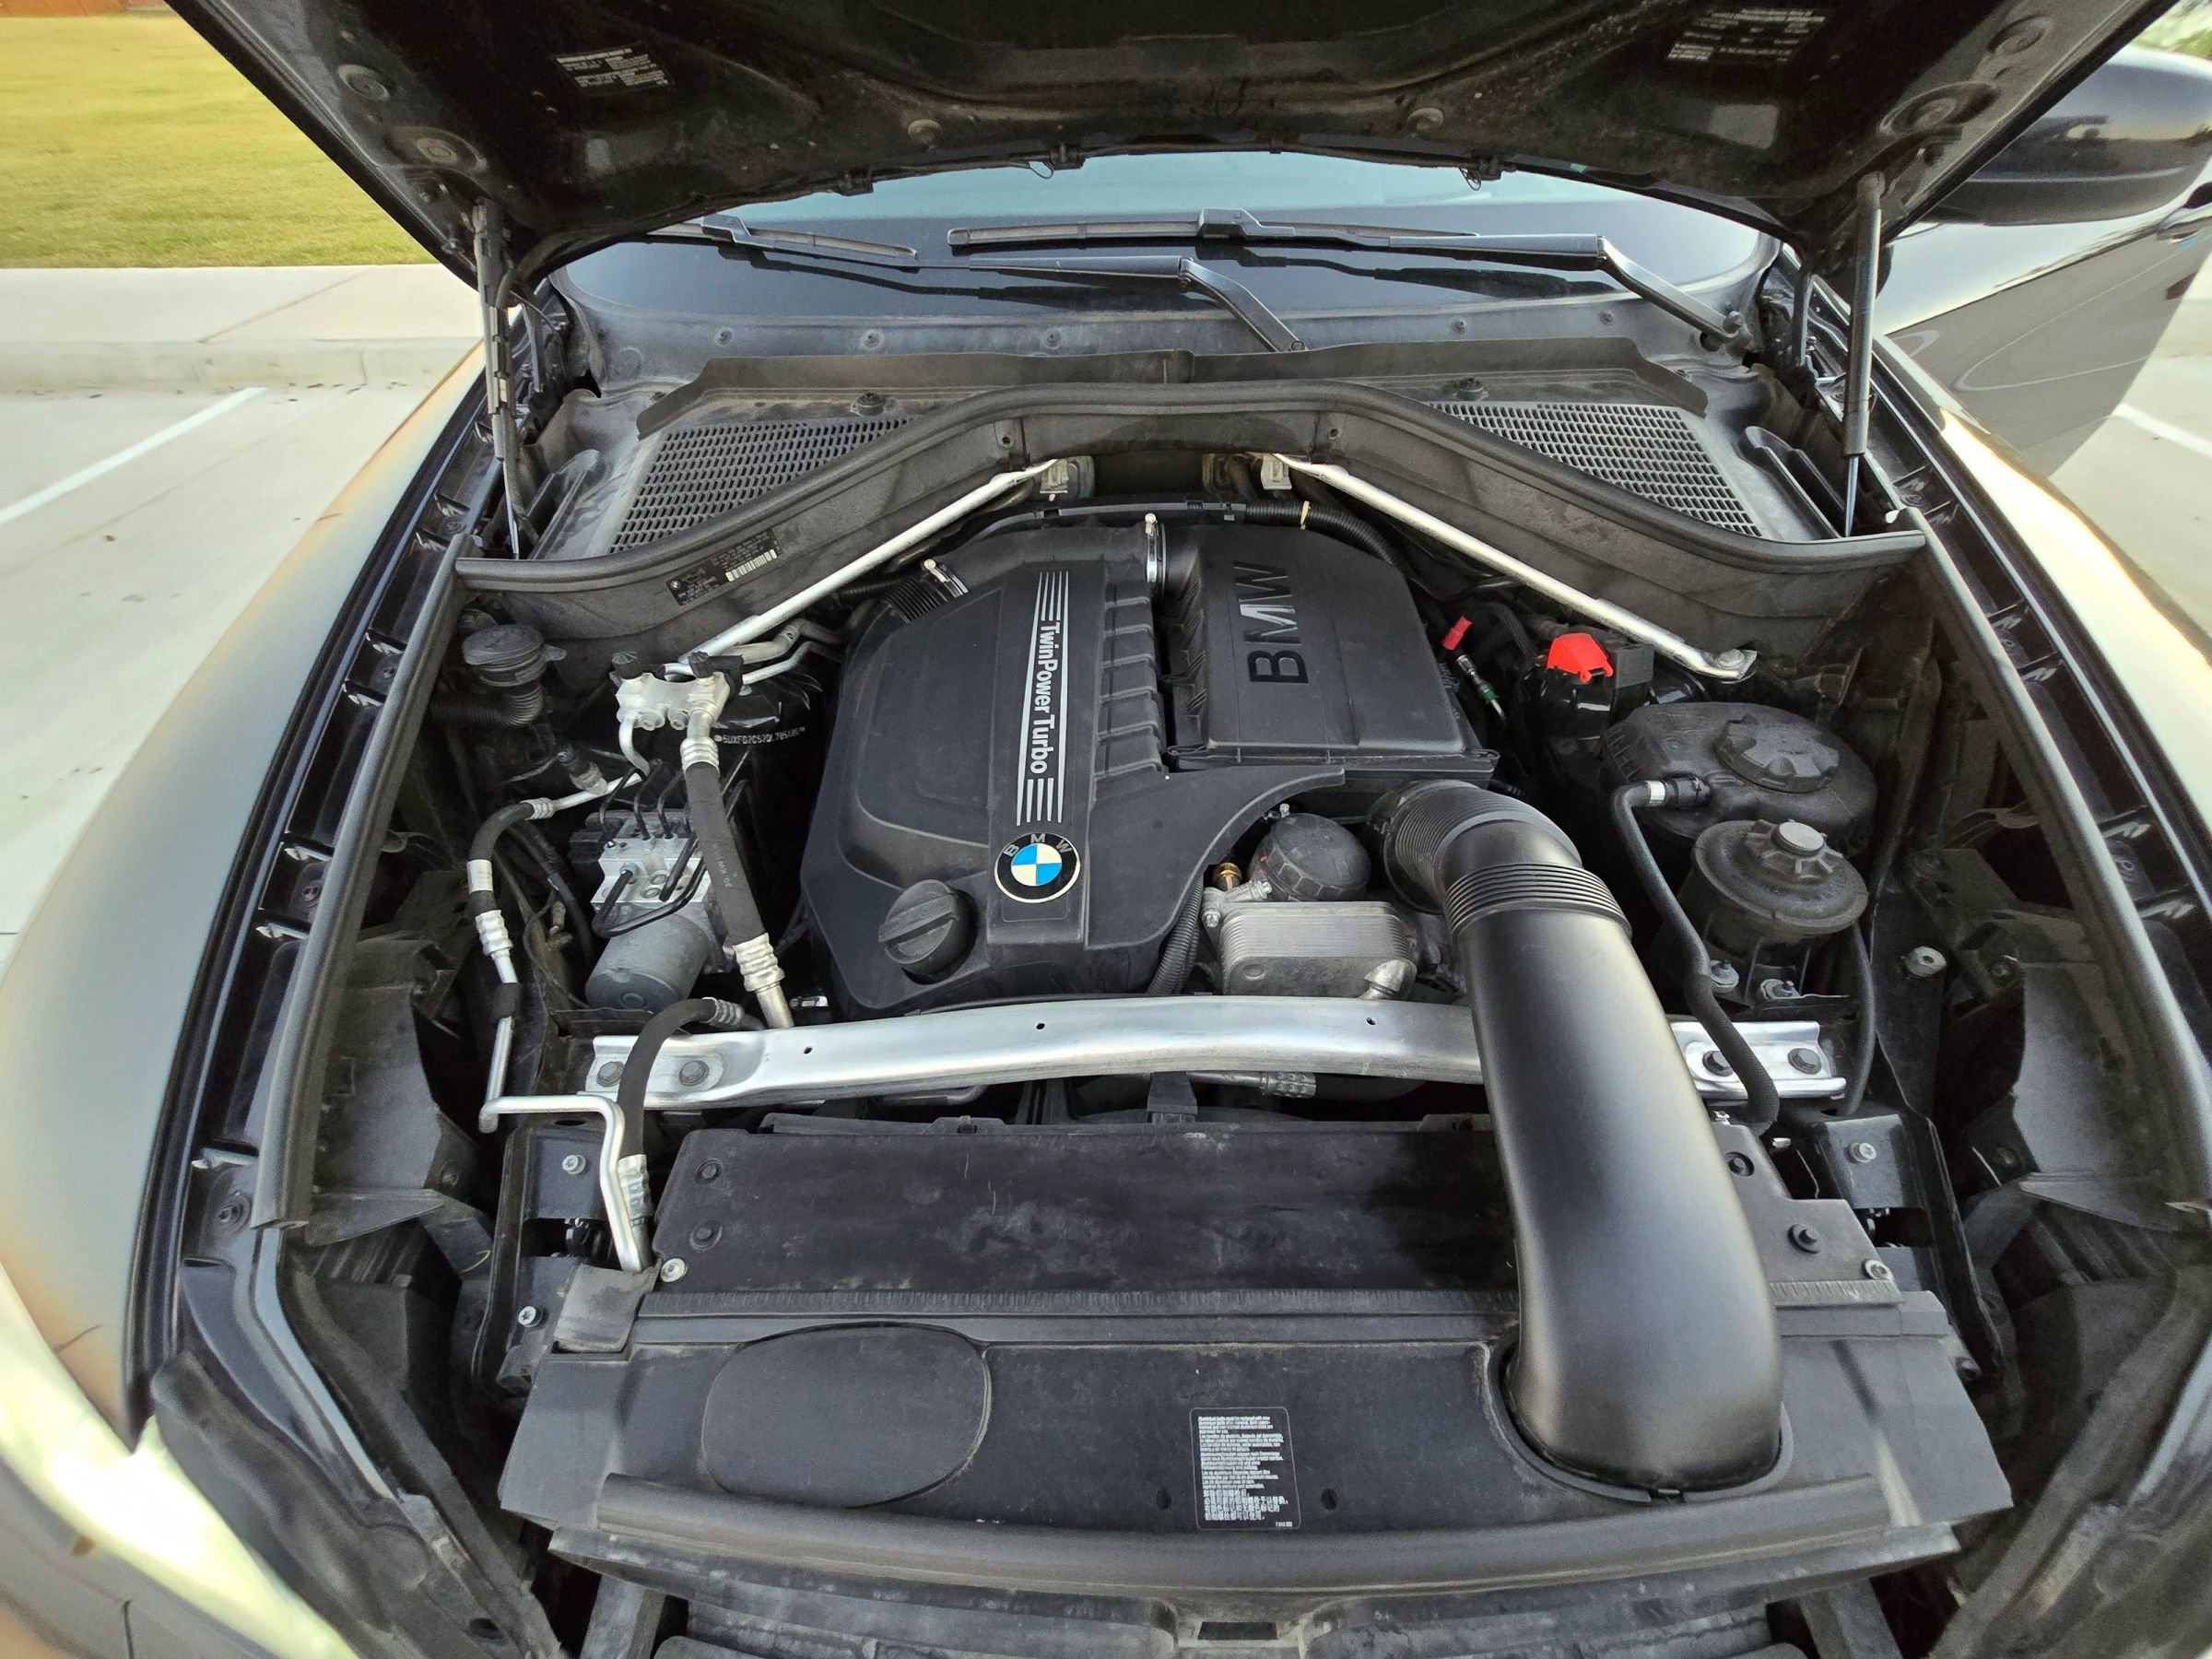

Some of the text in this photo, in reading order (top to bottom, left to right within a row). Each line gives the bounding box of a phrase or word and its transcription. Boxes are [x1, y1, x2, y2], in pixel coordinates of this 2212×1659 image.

[1232, 560, 1309, 684] BMW
[1030, 621, 1061, 774] TwinPower Turbo
[1004, 833, 1073, 857] BMW
